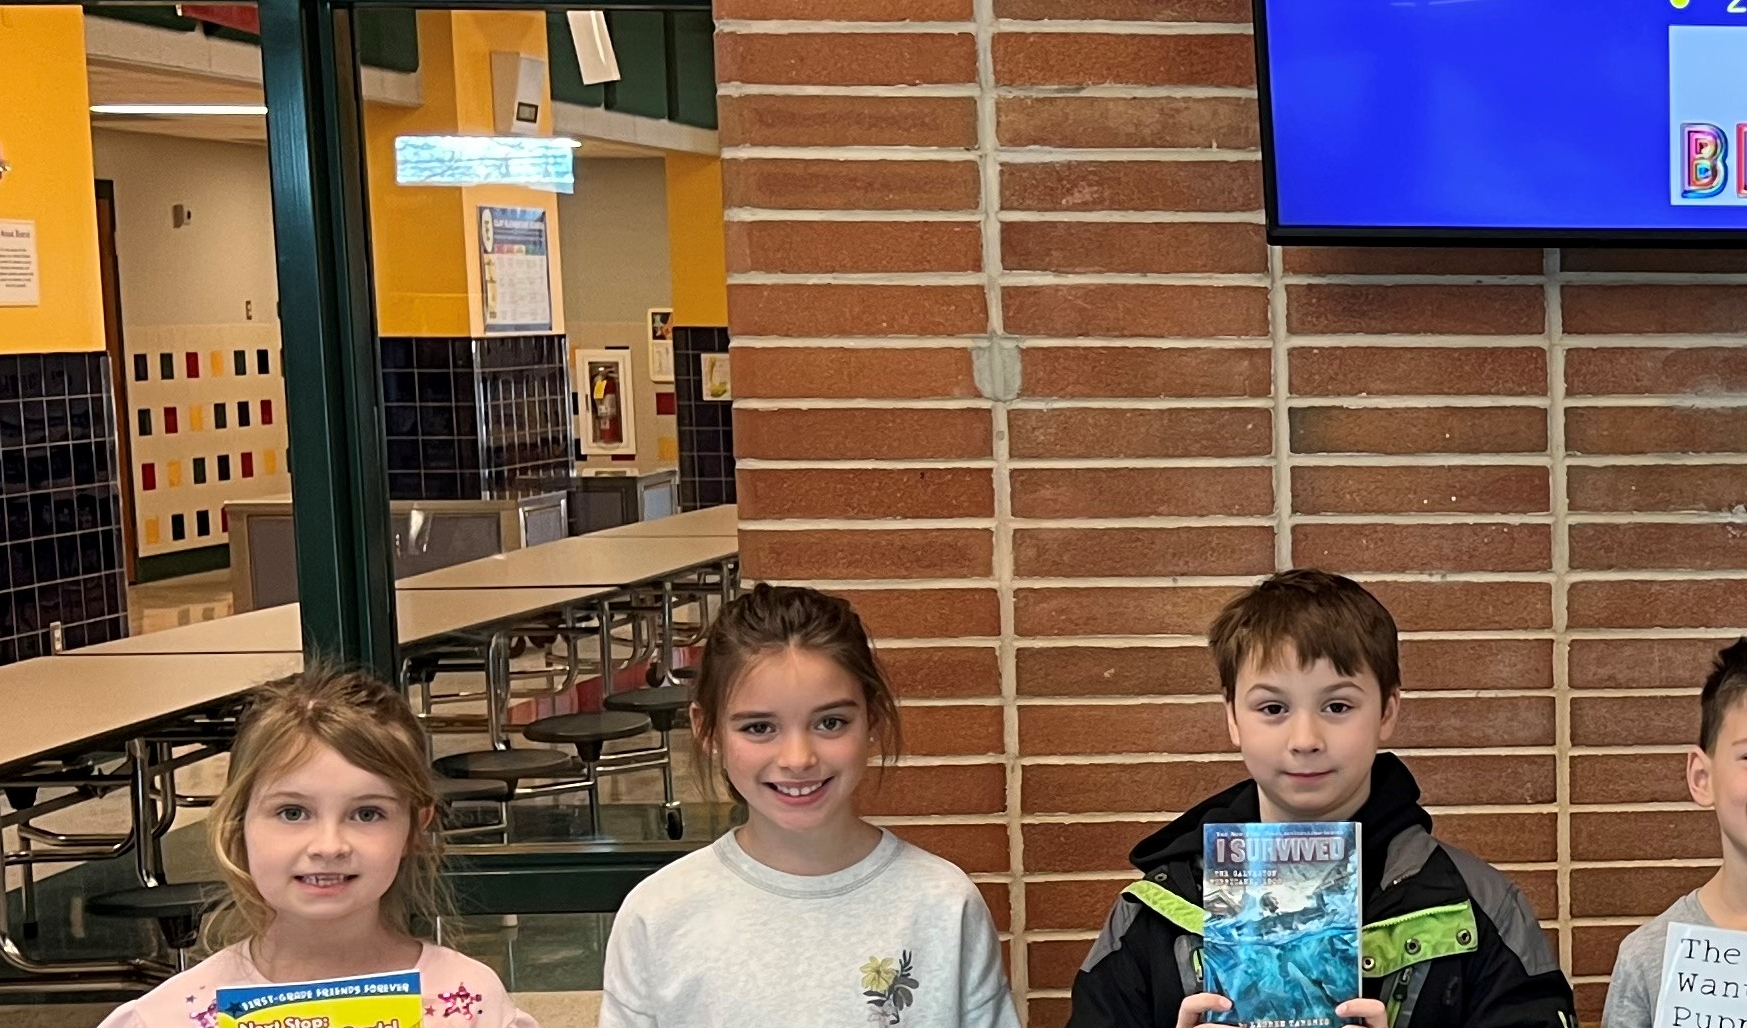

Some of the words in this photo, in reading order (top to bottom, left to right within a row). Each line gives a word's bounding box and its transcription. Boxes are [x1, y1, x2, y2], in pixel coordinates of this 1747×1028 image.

[1216, 838, 1225, 862] I
[1230, 837, 1345, 862] SURVIVED
[1681, 938, 1741, 965] The
[241, 991, 313, 1011] FIRST-GRADE
[316, 984, 361, 998] FRIENDS
[364, 982, 410, 994] FOREVER
